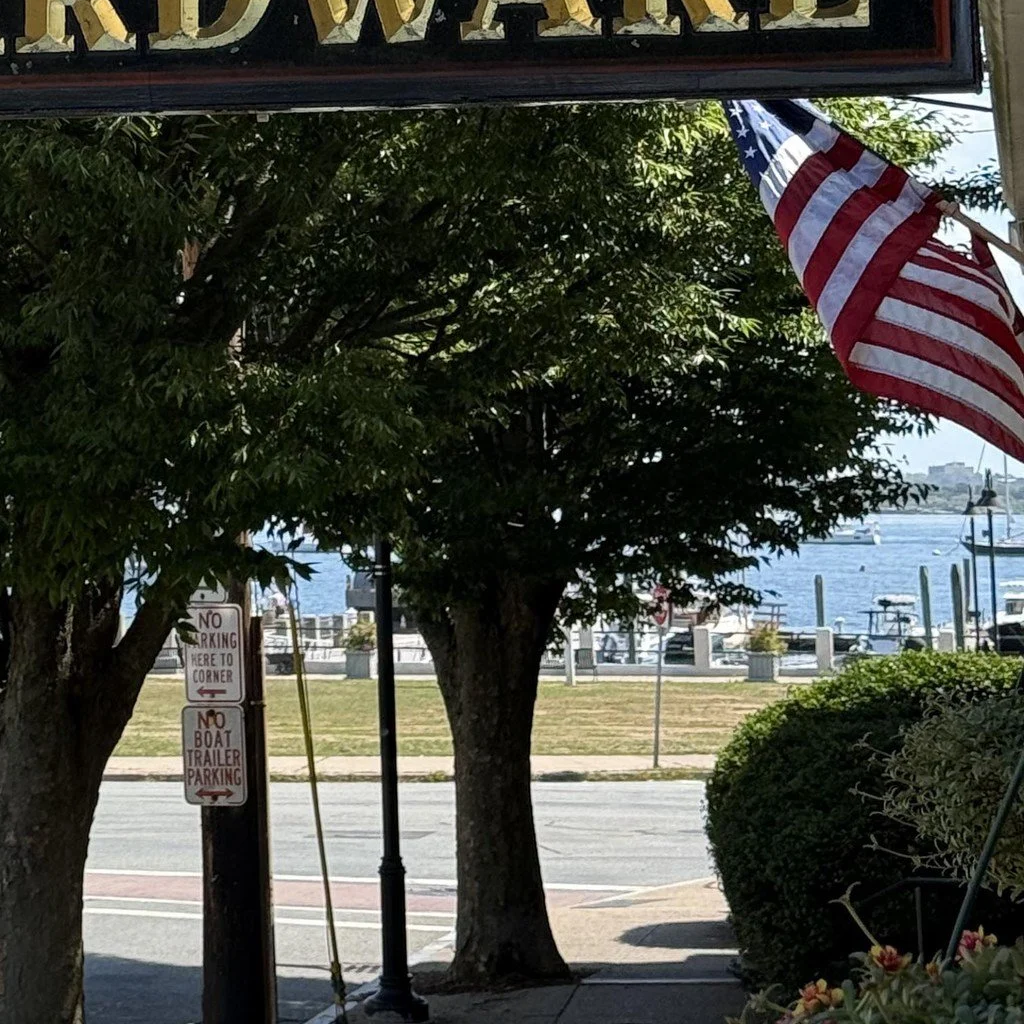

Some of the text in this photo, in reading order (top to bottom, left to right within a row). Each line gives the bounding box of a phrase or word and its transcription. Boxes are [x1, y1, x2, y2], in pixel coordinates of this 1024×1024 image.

[198, 611, 223, 630] NO
[188, 631, 238, 650] RKING
[191, 652, 234, 667] HERE TO
[192, 668, 234, 684] CORNER
[197, 710, 226, 730] NO
[194, 729, 232, 749] BOAT
[187, 748, 241, 767] TRAILER
[187, 767, 242, 787] PARKING
